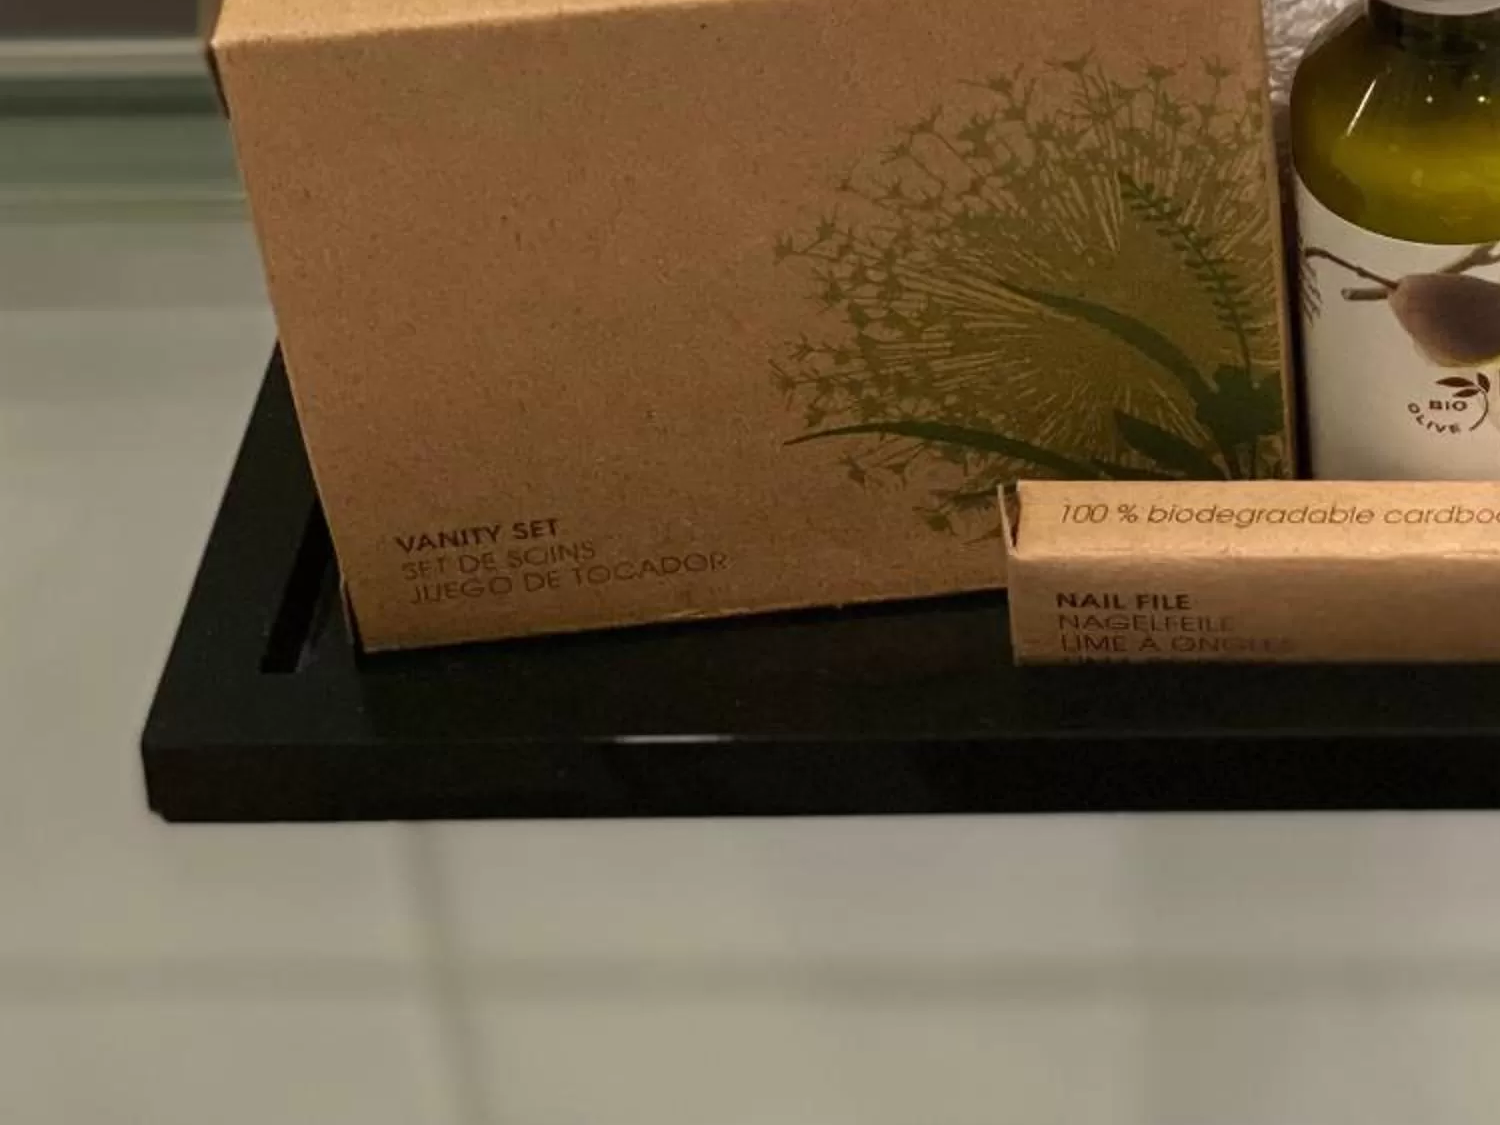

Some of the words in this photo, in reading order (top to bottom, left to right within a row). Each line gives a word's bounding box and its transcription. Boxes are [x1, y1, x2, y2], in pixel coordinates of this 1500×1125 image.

[1408, 402, 1461, 434] OLIVE
[1429, 400, 1468, 412] BIO
[1060, 503, 1108, 525] 100
[1118, 504, 1139, 524] %
[1148, 503, 1375, 529] biodegradable
[395, 526, 501, 554] VANITY
[512, 518, 560, 541] SET
[402, 557, 447, 581] SET
[459, 553, 497, 575] DE
[410, 576, 513, 605] JUEGO
[524, 569, 562, 593] DE
[572, 551, 728, 588] TOCADOR
[1056, 593, 1125, 610] NAIL
[1136, 594, 1192, 611] FILE
[1059, 614, 1236, 633] NAGELFEILE
[1061, 635, 1127, 653] LIME
